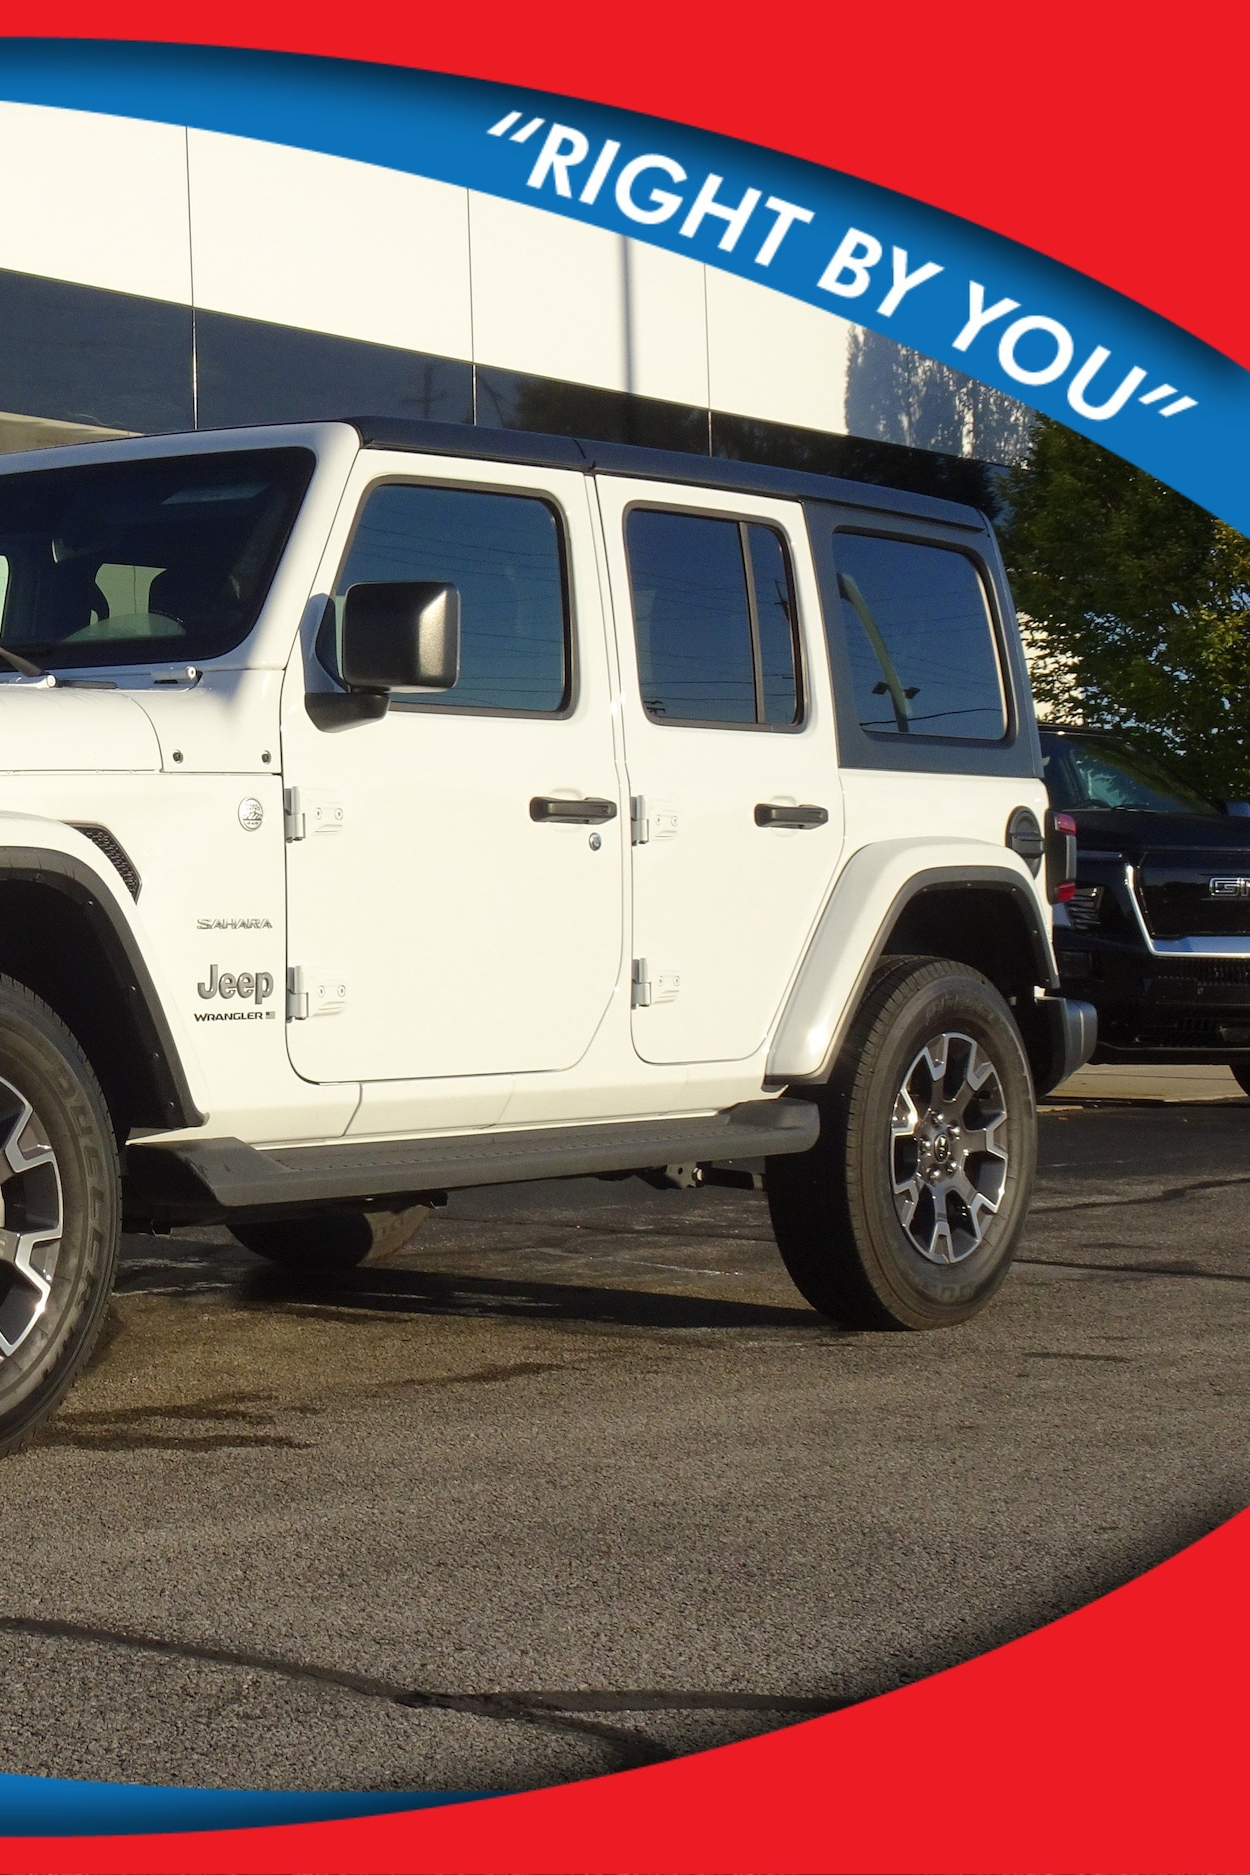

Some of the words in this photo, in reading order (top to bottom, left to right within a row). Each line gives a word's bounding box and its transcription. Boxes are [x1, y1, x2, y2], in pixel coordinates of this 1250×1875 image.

[197, 918, 273, 930] SAHARA
[197, 964, 274, 1005] Jeep
[194, 1011, 264, 1022] WRANGLER
